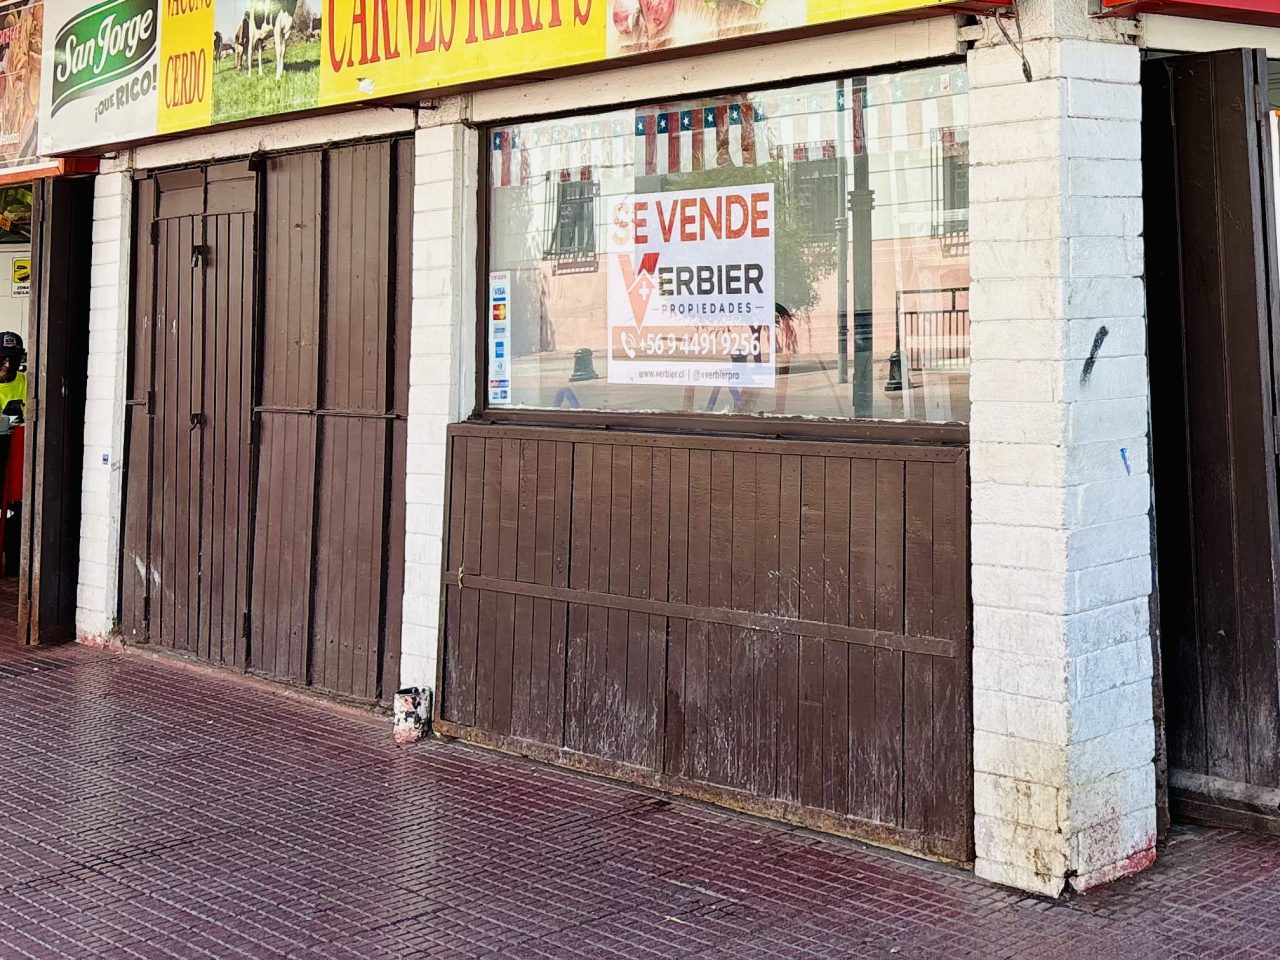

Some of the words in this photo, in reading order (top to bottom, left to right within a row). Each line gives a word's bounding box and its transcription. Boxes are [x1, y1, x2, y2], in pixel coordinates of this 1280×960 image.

[57, 34, 95, 83] San
[93, 8, 154, 75] Jorge
[115, 62, 158, 110] RICO!
[164, 47, 207, 110] CERDO
[611, 201, 649, 246] SE
[655, 191, 770, 243] VENDE
[661, 302, 752, 315] PROPIEDADES
[639, 332, 664, 355] +56
[665, 332, 677, 354] 9
[679, 332, 719, 356] 4491
[720, 331, 761, 357] 9256
